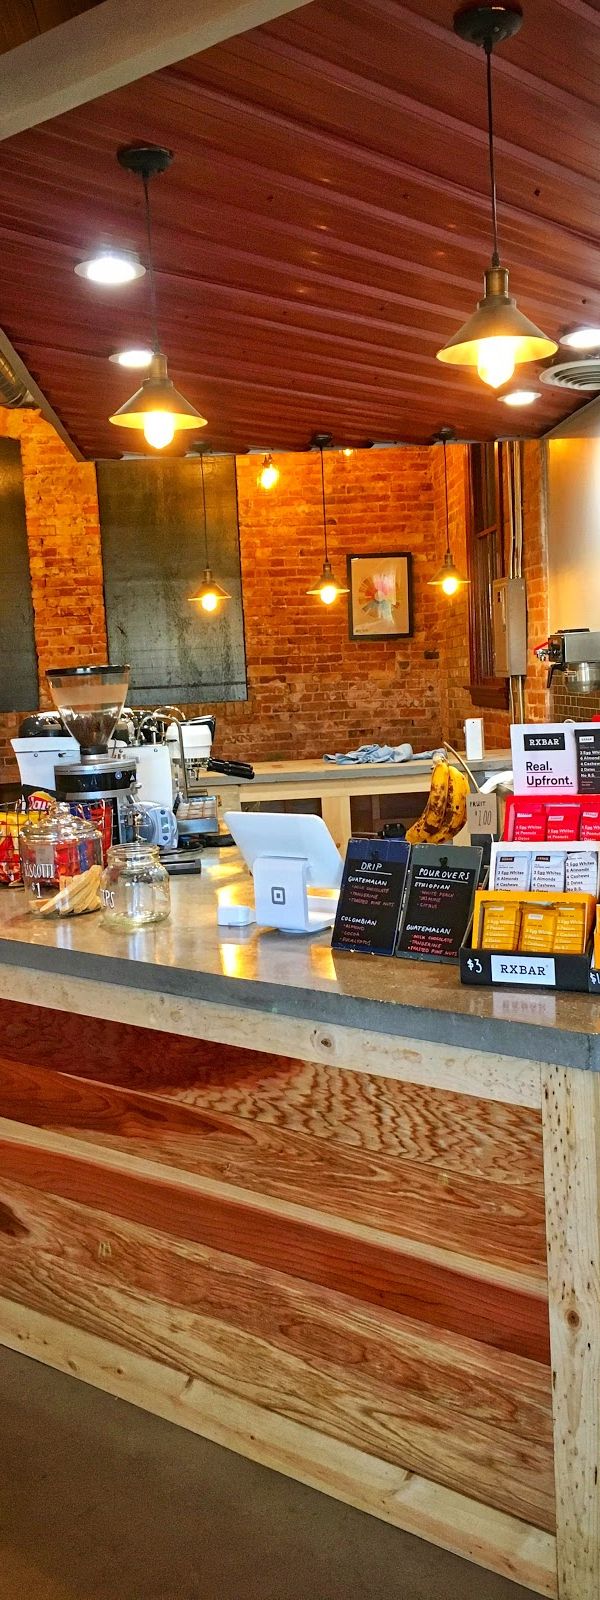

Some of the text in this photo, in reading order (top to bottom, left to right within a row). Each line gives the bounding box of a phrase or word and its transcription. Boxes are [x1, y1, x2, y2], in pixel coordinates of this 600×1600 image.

[529, 738, 560, 746] RXBAR
[526, 761, 552, 771] Real.
[526, 776, 573, 787] Upfront.
[361, 862, 382, 871] DRIP
[348, 876, 387, 886] GUATEMALAN
[414, 882, 450, 890] ETHIOPIAN
[32, 882, 42, 898] $1
[341, 916, 377, 926] COLOMBIAN
[406, 924, 451, 935] GUATEMALAN
[467, 958, 482, 973] $3
[500, 964, 546, 975] RXBAR
